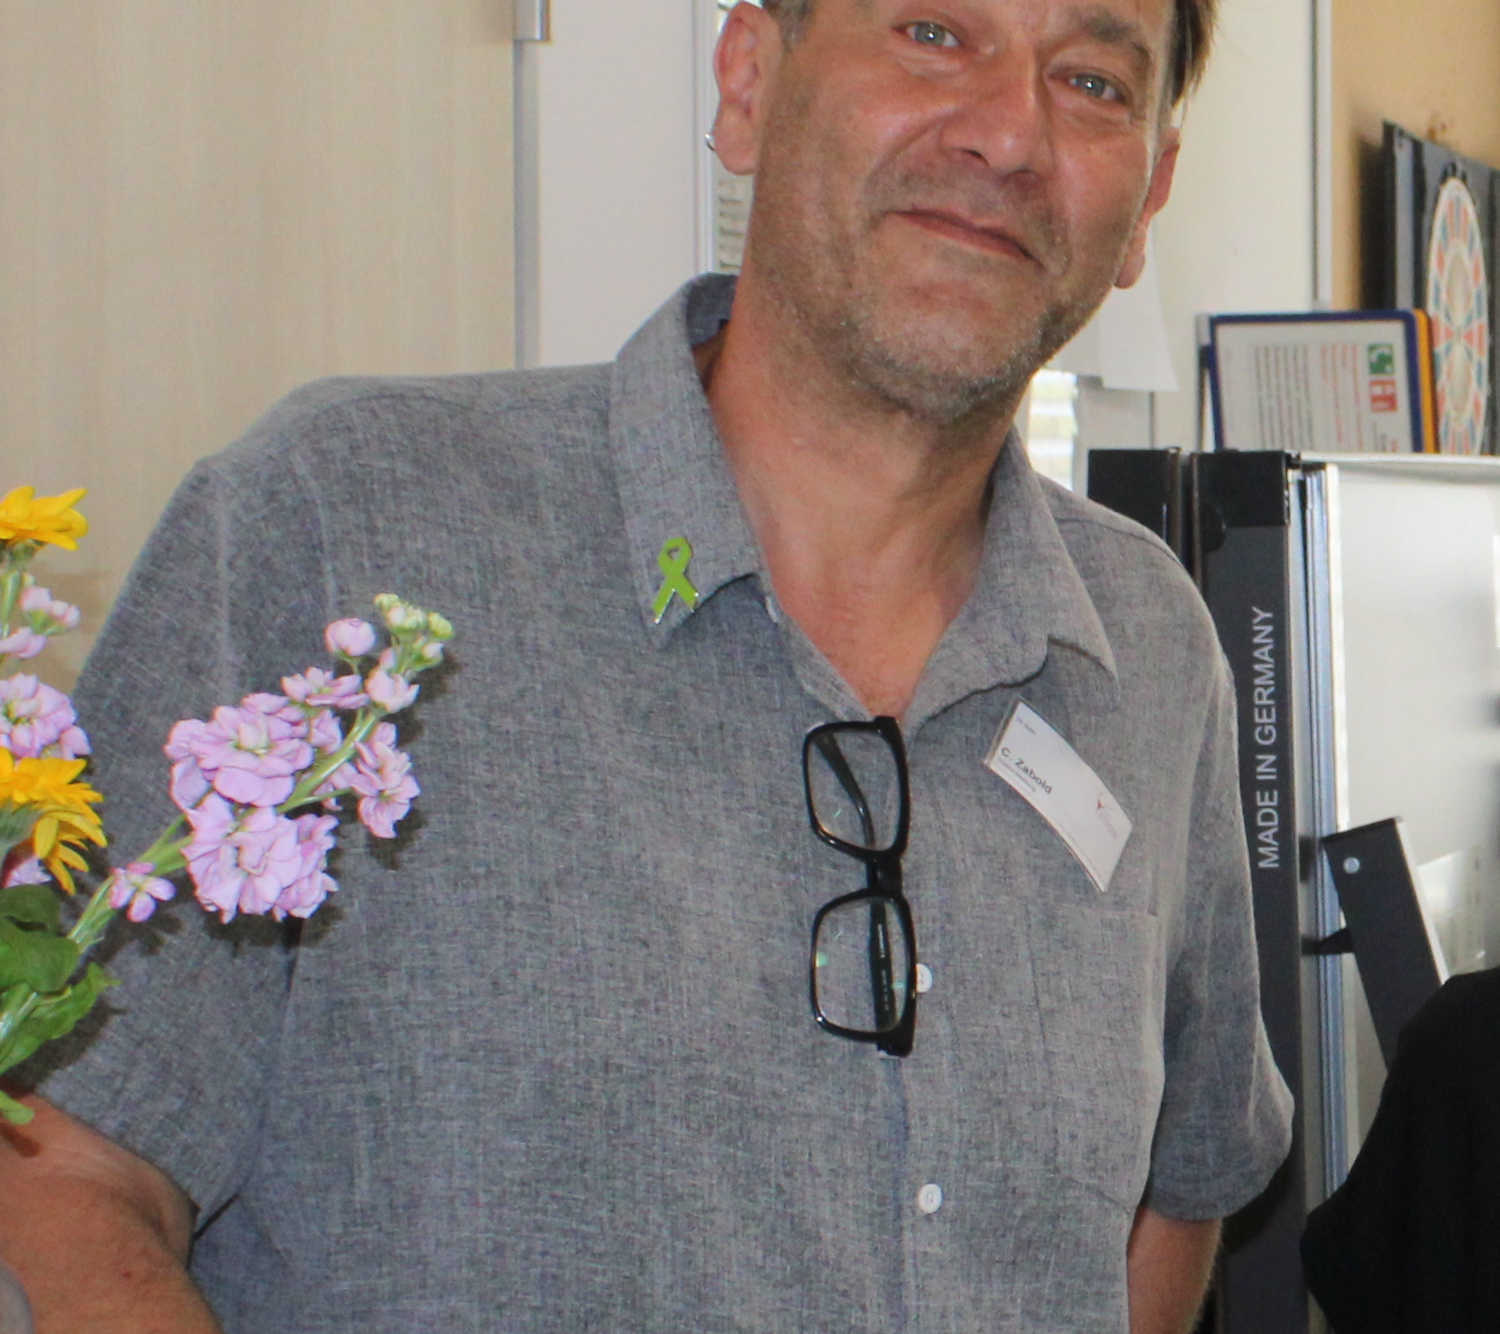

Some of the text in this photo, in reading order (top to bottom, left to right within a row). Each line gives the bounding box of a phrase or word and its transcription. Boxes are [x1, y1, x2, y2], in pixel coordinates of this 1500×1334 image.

[1000, 746, 1013, 762] C.
[1014, 757, 1053, 795] Zabold
[1251, 605, 1280, 868] MADE IN GERMANY
